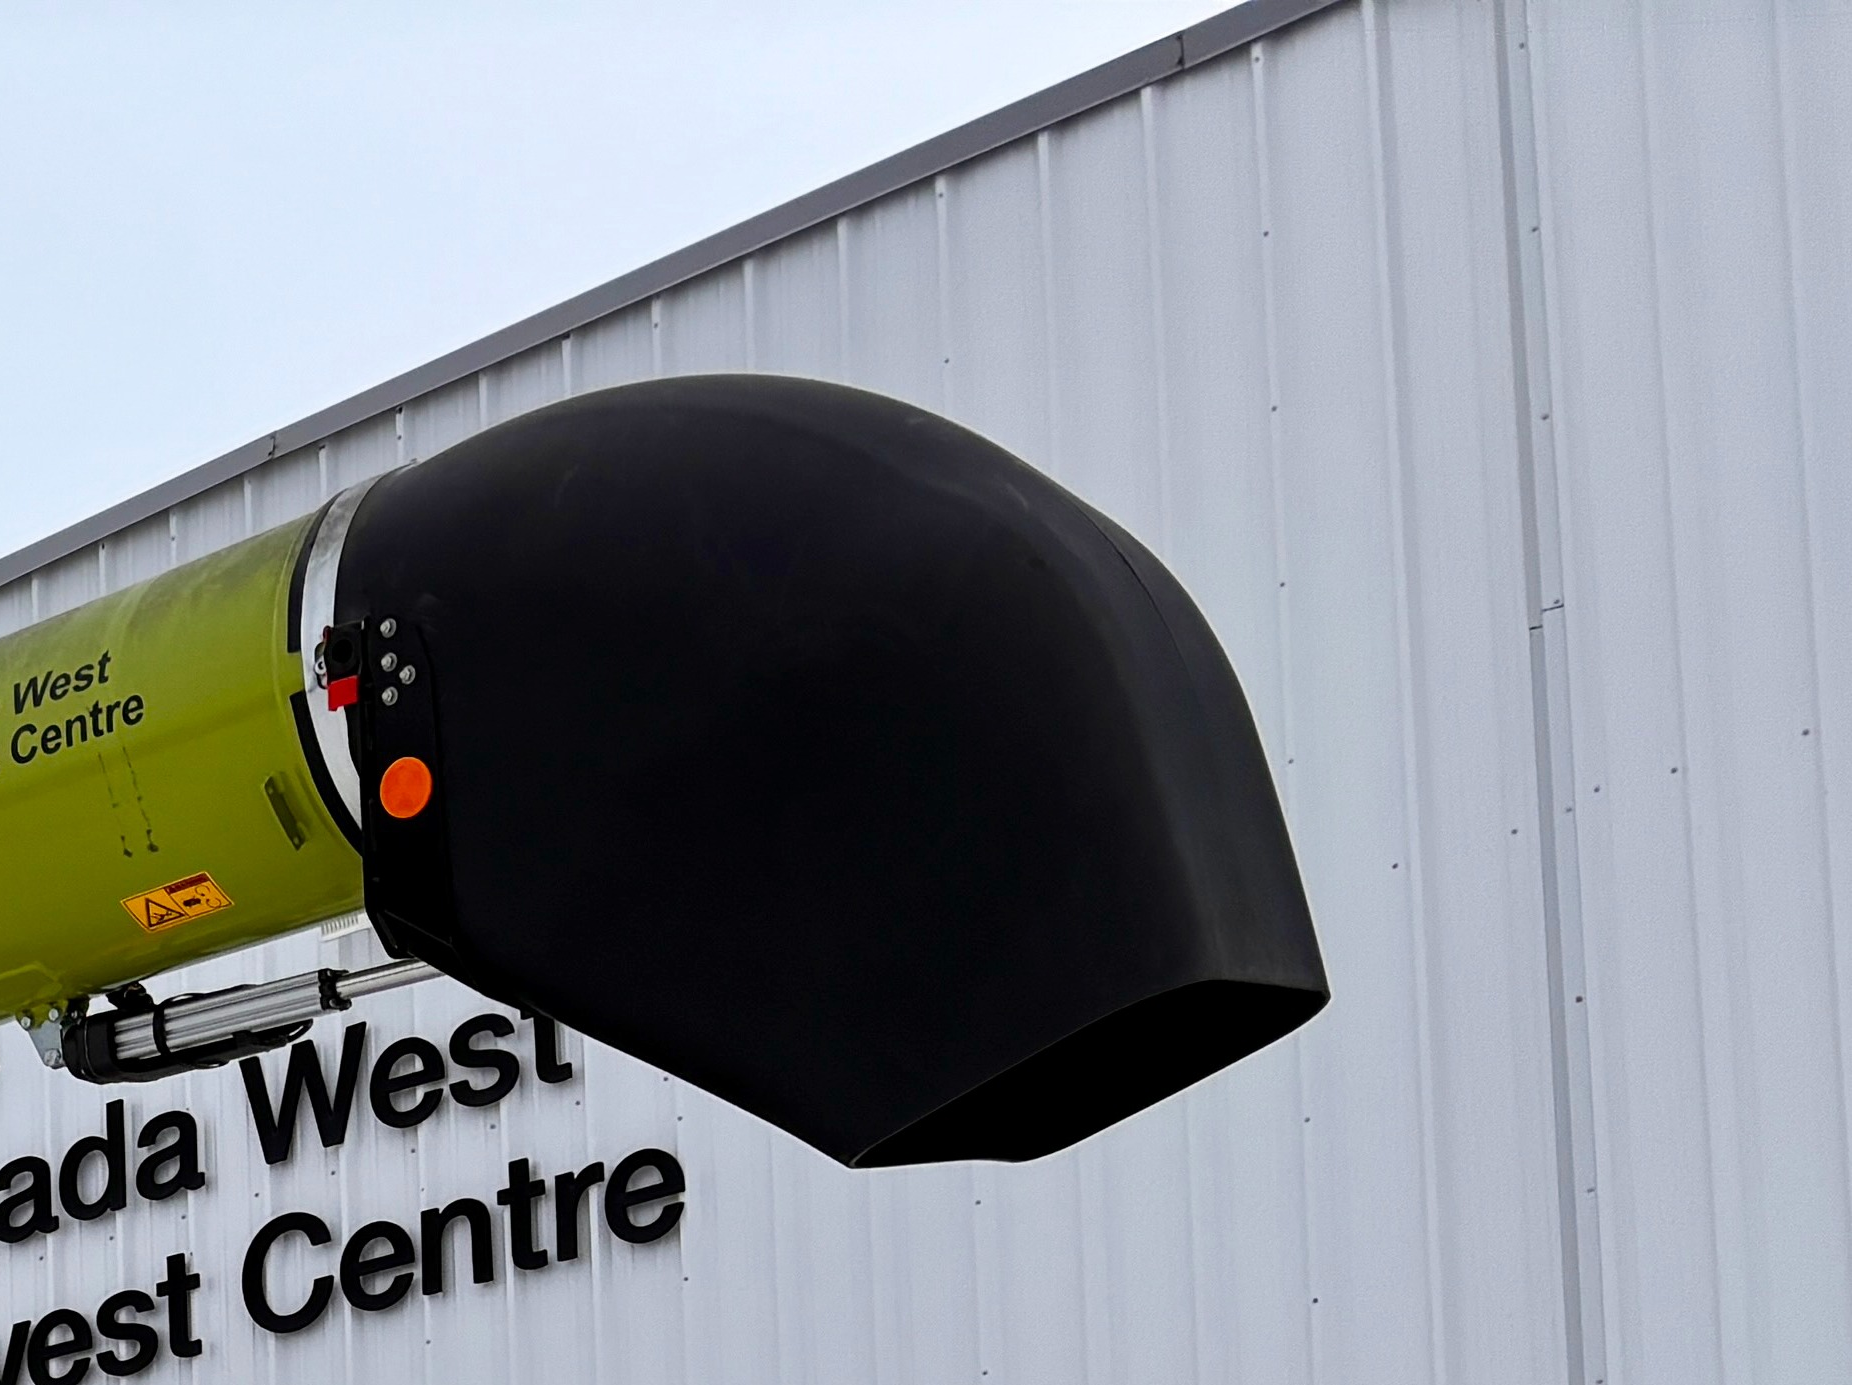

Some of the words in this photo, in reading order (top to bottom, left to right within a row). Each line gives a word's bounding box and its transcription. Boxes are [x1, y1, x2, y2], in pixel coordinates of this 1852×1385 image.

[10, 694, 144, 765] Centre
[13, 649, 111, 715] West
[239, 1009, 573, 1166] West
[242, 1146, 687, 1334] Centre
